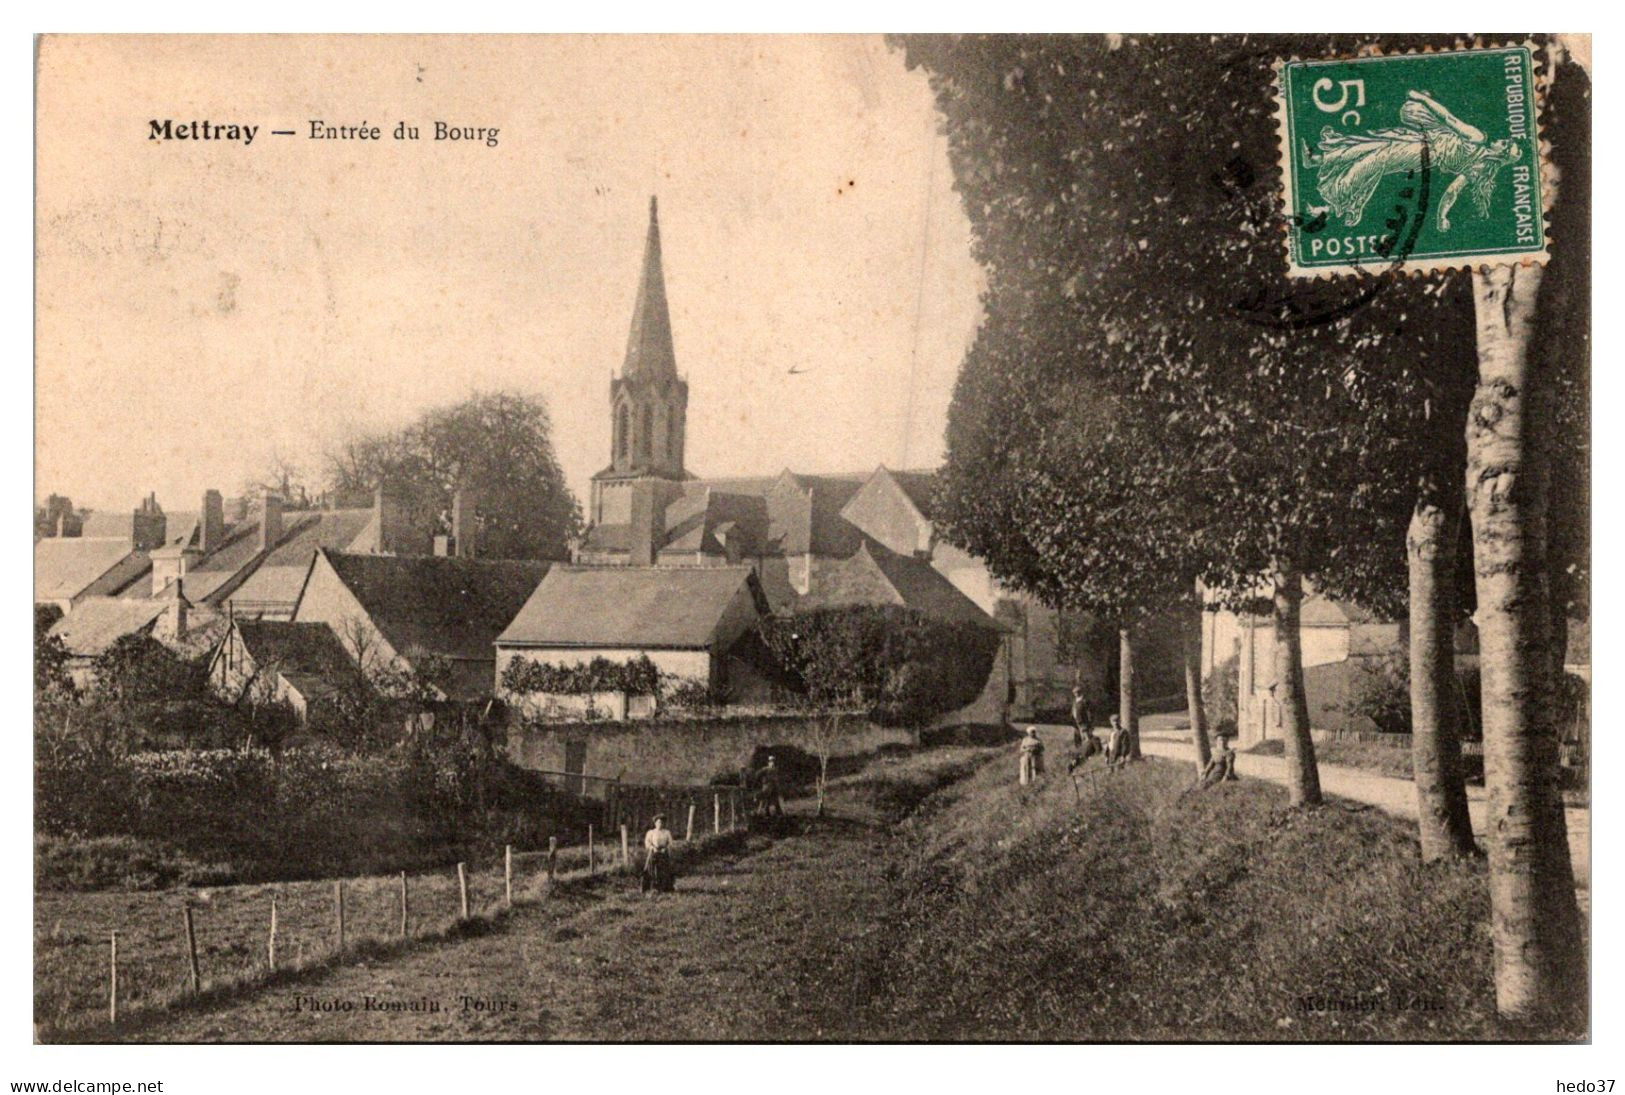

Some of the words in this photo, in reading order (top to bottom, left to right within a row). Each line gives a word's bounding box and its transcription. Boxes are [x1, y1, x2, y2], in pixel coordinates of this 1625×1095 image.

[1504, 54, 1527, 140] REPUBLIQUE
[149, 119, 259, 146] Mettray
[308, 120, 381, 140] Entrée
[393, 121, 419, 140] du
[434, 121, 501, 147] Bourg
[1513, 165, 1534, 244] FRANÇAISE
[294, 995, 352, 1013] Photo
[459, 995, 519, 1013] Tours
